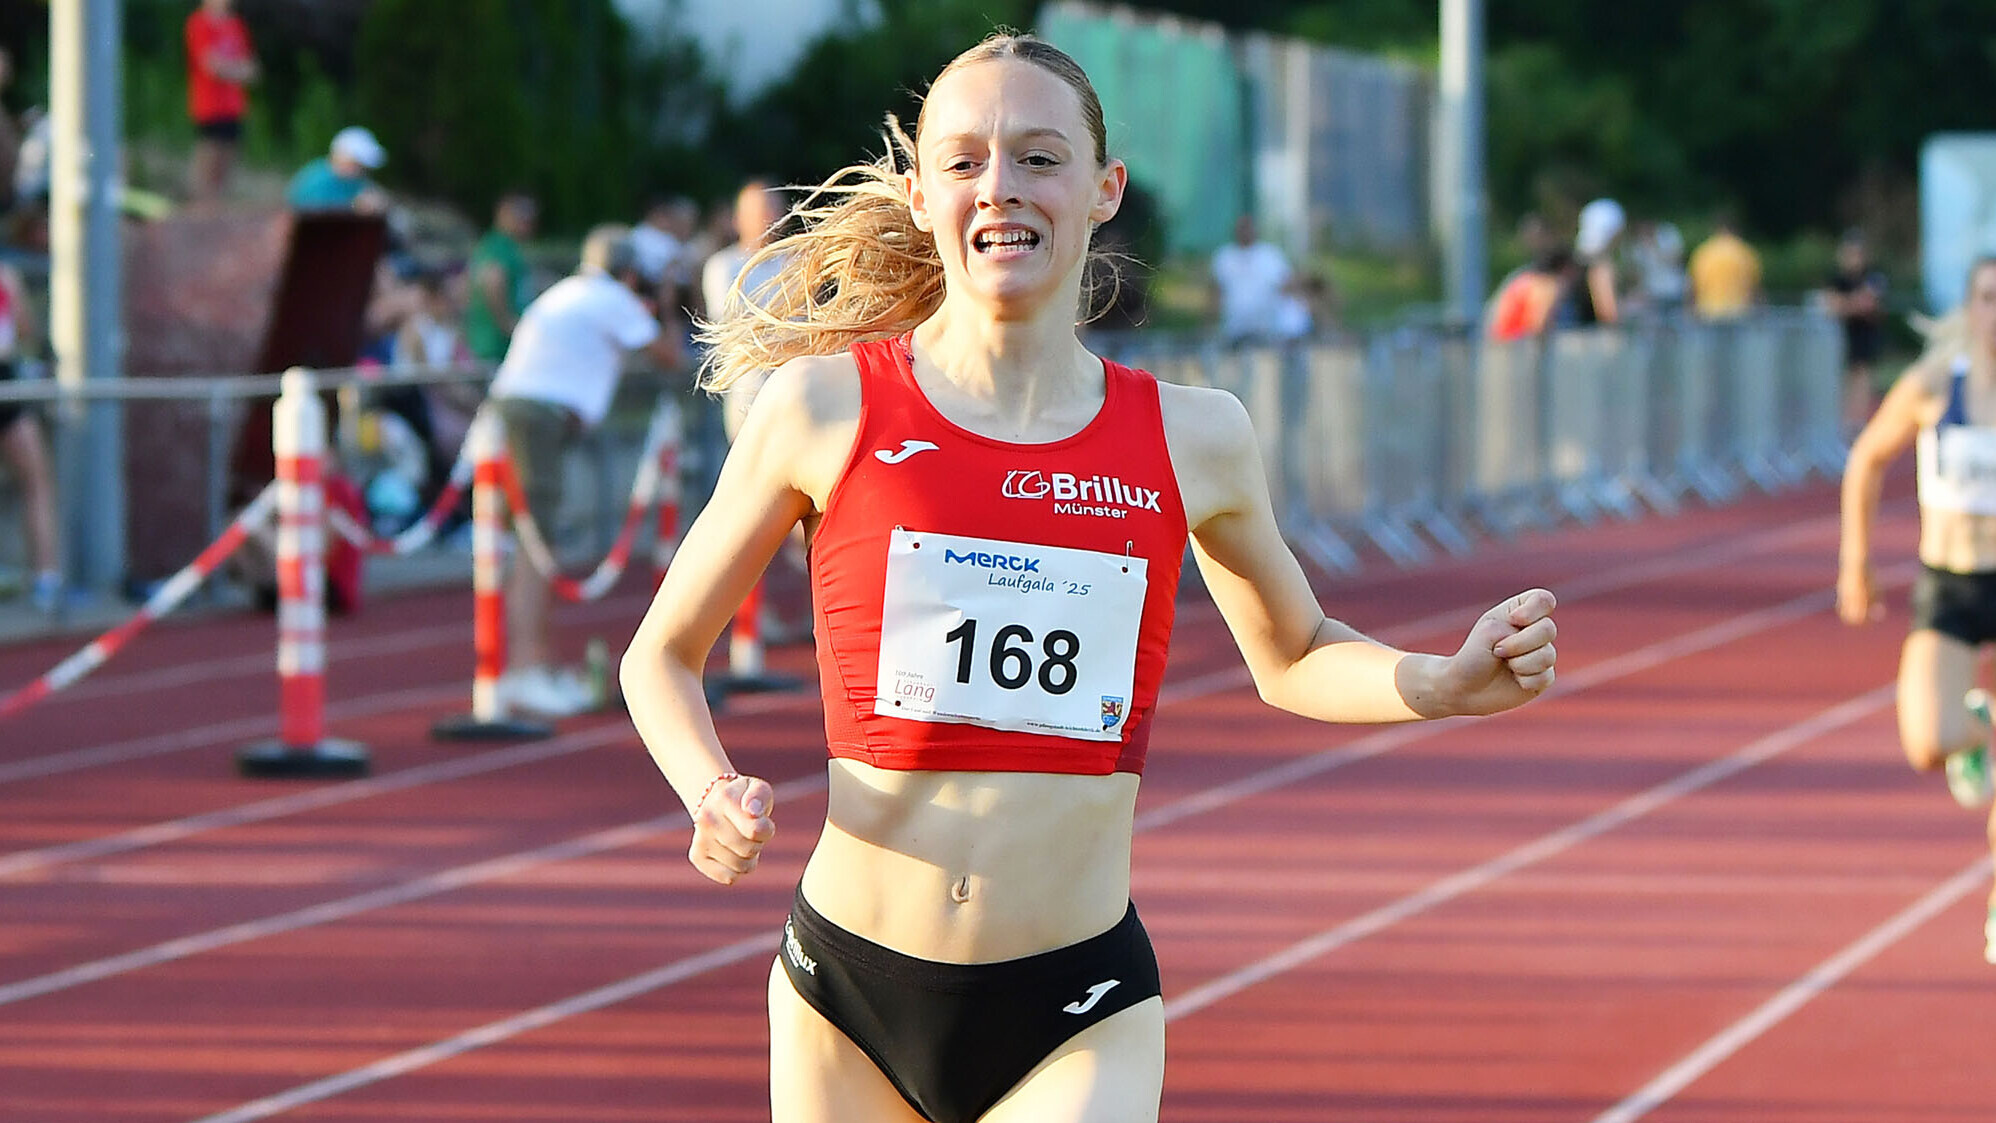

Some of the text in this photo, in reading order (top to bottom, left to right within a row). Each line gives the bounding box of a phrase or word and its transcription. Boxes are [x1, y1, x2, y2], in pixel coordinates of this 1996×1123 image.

[1051, 473, 1162, 513] Brillux
[1053, 503, 1128, 519] Münster
[988, 573, 1055, 594] Laufgala
[945, 618, 1080, 695] 168
[895, 679, 935, 703] Lang
